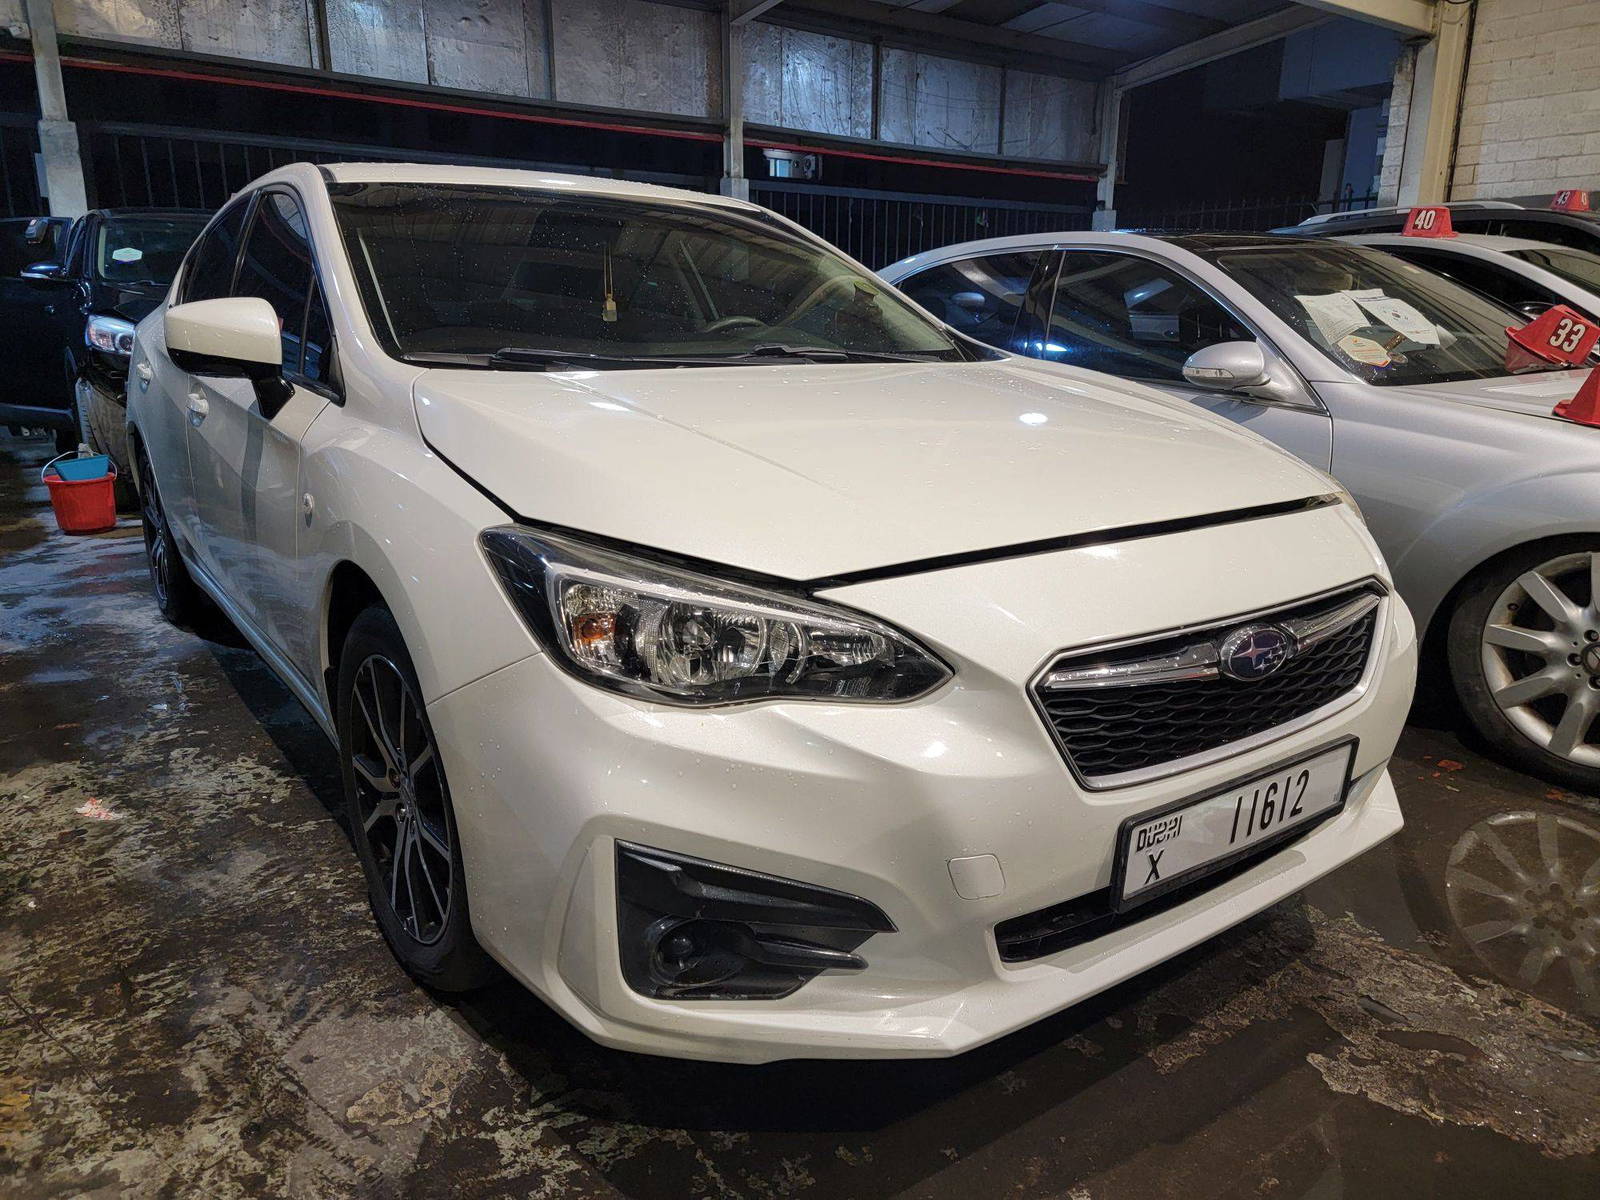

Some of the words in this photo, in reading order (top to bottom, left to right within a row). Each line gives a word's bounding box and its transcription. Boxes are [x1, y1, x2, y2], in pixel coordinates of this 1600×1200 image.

[1414, 210, 1436, 230] 40
[1549, 318, 1586, 353] 33
[1229, 769, 1310, 845] 11612
[1144, 849, 1165, 885] X
